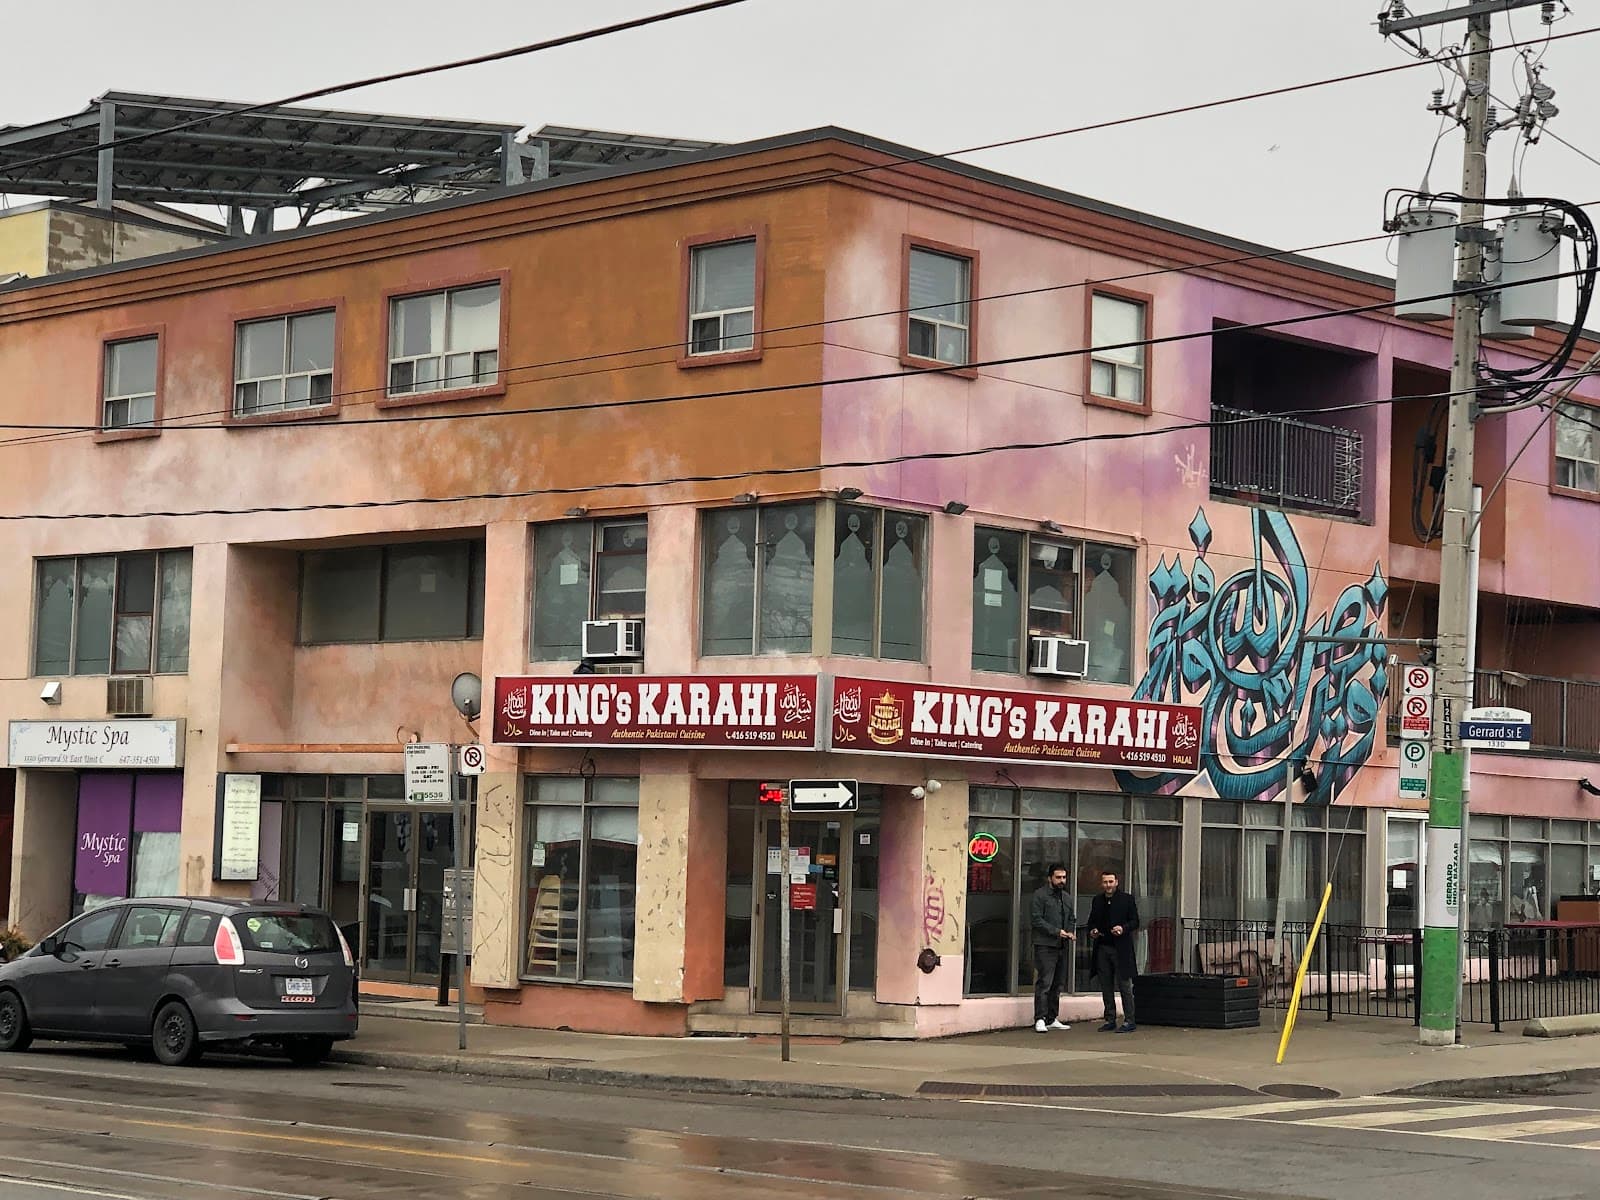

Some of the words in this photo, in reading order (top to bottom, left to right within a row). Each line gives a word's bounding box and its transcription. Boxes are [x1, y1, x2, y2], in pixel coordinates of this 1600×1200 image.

[530, 683, 631, 725] KING's
[637, 682, 778, 726] KARAHI
[870, 715, 901, 730] KARAHI
[911, 690, 1027, 740] KING's
[1032, 700, 1169, 749] KARAHI
[503, 721, 523, 737] حلال
[572, 730, 593, 738] Catering
[611, 728, 644, 738] Authentic
[646, 729, 678, 739] Pakistani
[680, 729, 706, 739] Cuisine
[731, 731, 744, 740] 416
[745, 732, 757, 740] 519
[758, 732, 776, 741] 4510
[782, 730, 808, 740] HALAL
[834, 725, 857, 742] حلال
[1468, 725, 1505, 738] Gerrard
[1506, 729, 1514, 739] St
[1516, 726, 1522, 738] E
[46, 725, 98, 752] Mystic
[102, 725, 130, 752] Spa
[910, 737, 924, 746] Dine
[924, 738, 931, 747] In
[934, 738, 947, 747] Take
[960, 741, 983, 750] Catering
[1003, 742, 1040, 754] Authentic
[1041, 745, 1075, 757] Pakistani
[1076, 747, 1101, 759] Cuisine
[1126, 751, 1138, 761] 416
[1139, 753, 1150, 762] 519
[1151, 753, 1166, 763] 4510
[1172, 755, 1193, 765] HALAL
[80, 832, 126, 858] Mystic
[970, 839, 996, 856] OPEN
[102, 851, 121, 867] Spa
